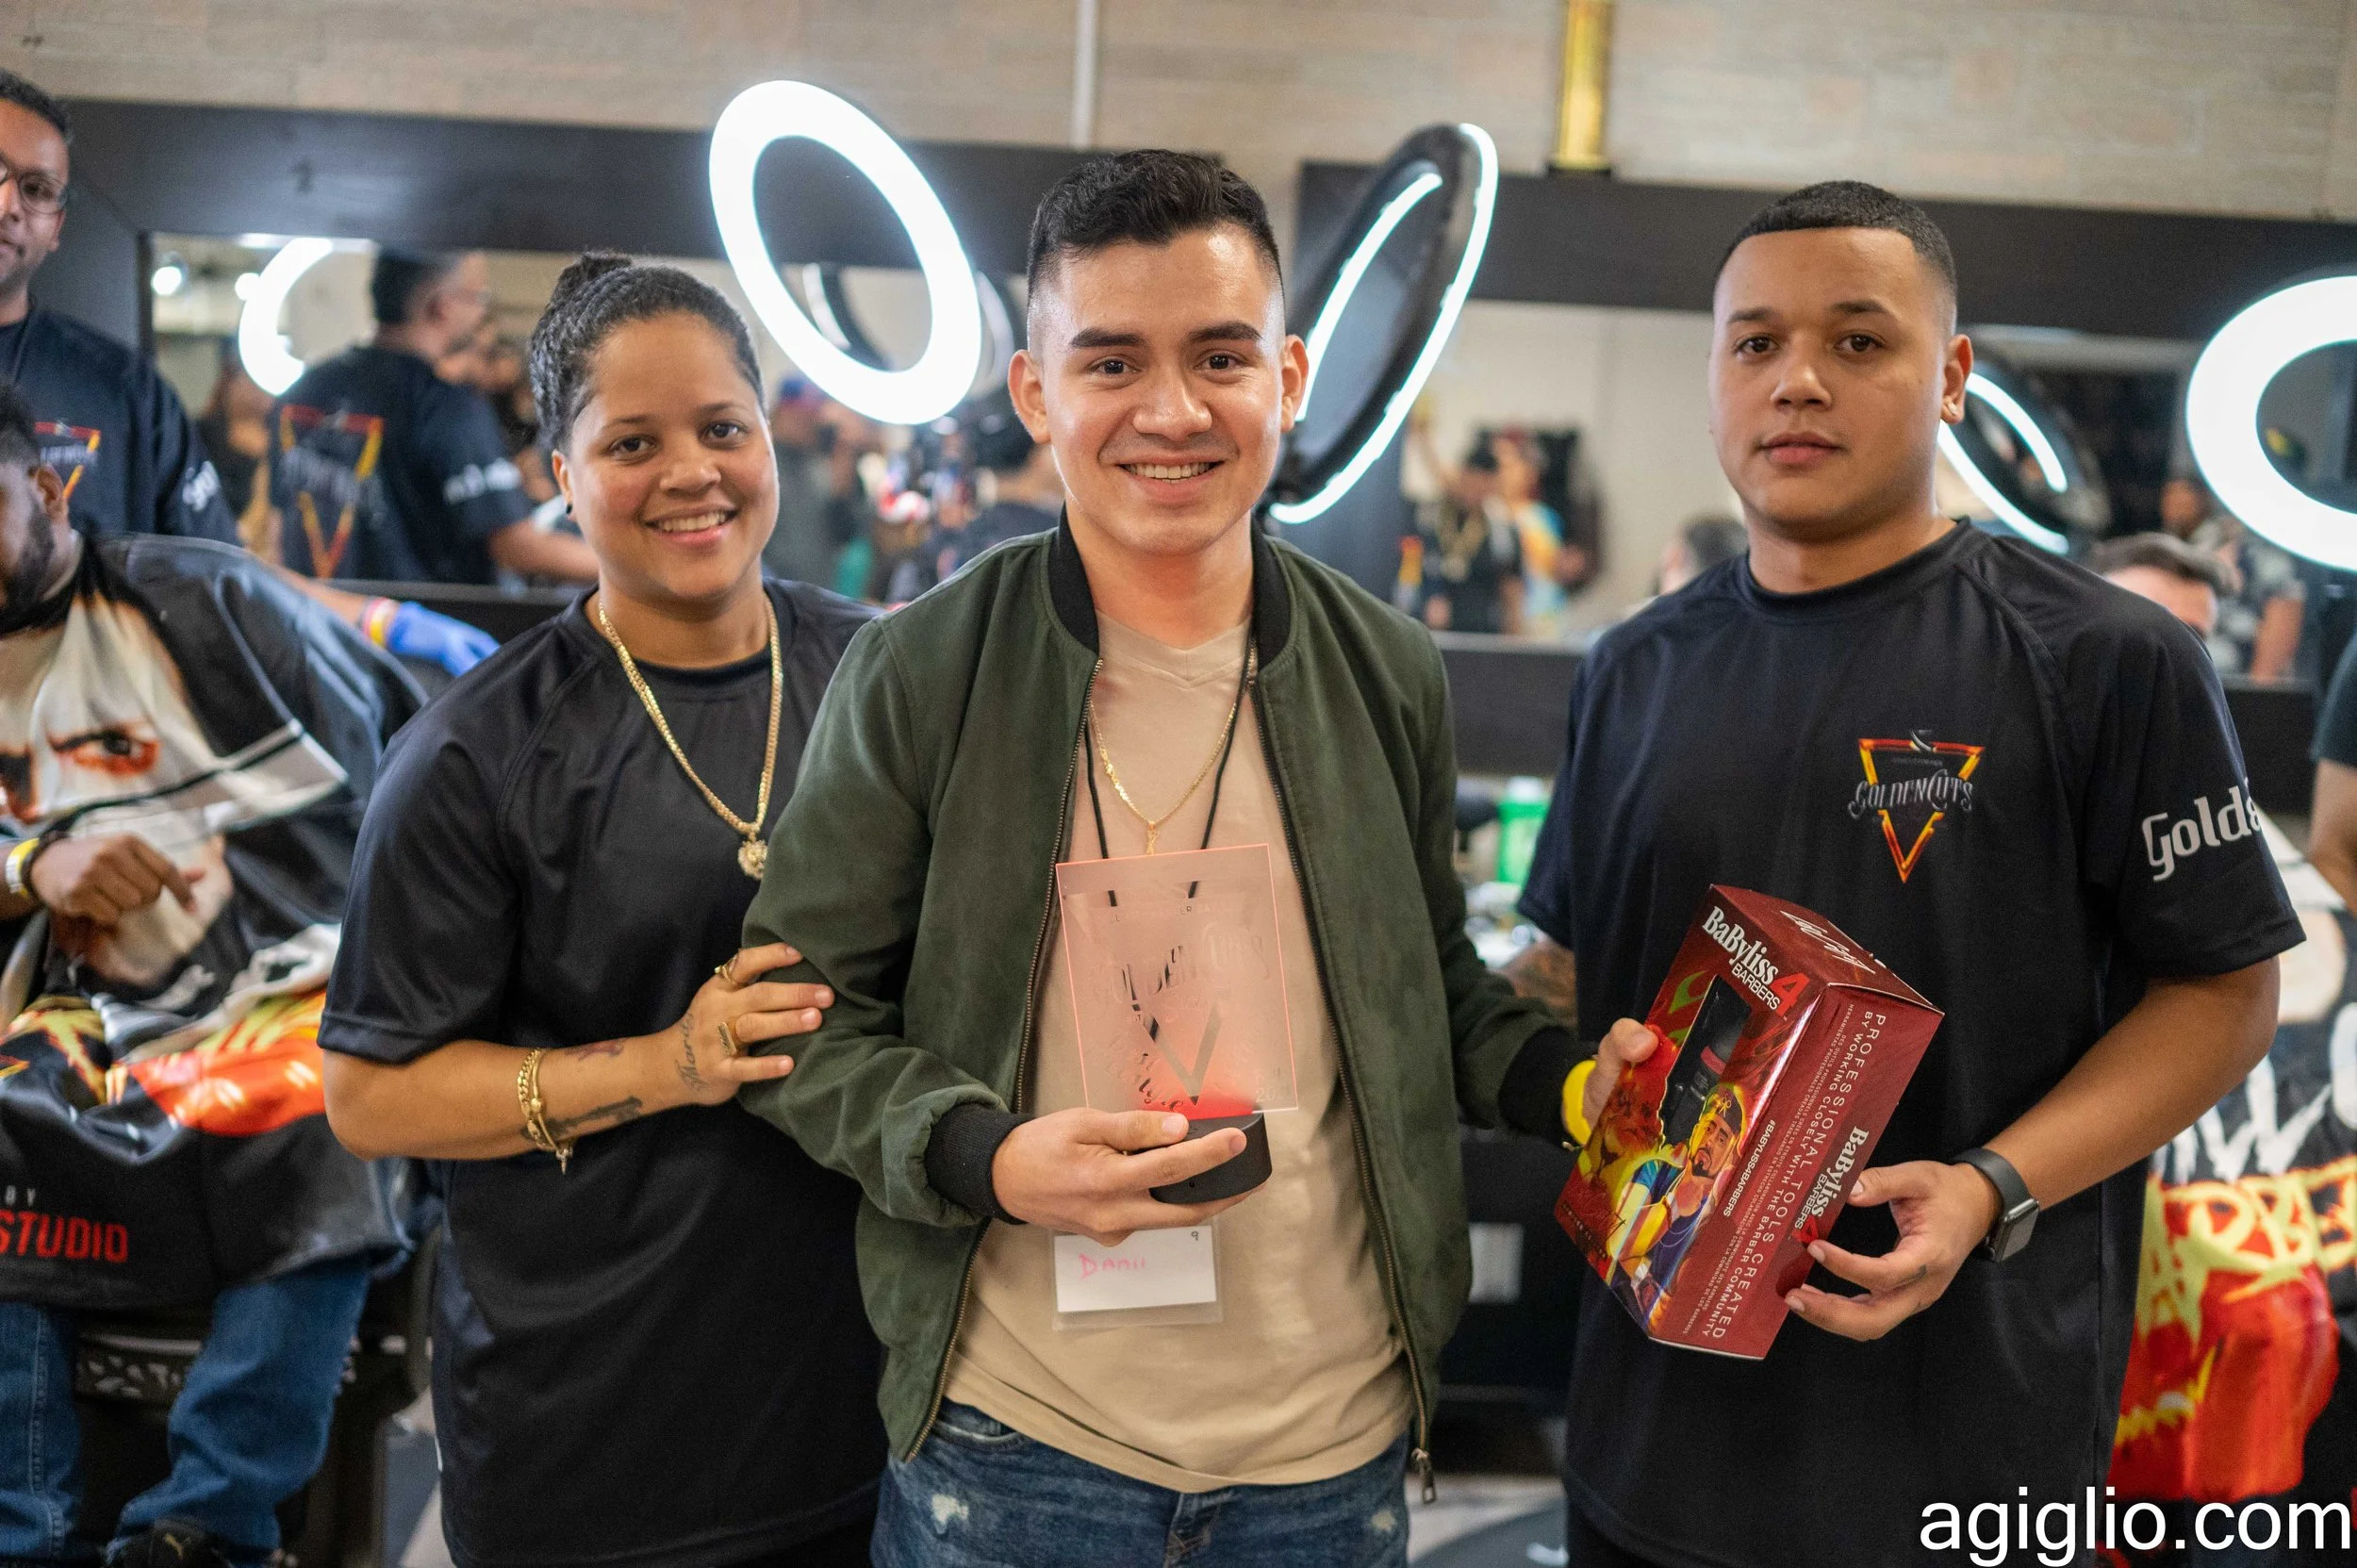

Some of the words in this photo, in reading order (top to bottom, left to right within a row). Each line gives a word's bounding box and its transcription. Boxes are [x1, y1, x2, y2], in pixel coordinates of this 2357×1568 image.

[1701, 904, 1779, 986] BaByliss
[1768, 972, 1810, 1019] 4
[1731, 962, 1781, 1011] BARBERS
[1859, 1010, 1873, 1028] BY
[1827, 1032, 1864, 1091] WORKING
[1798, 1013, 1887, 1170] PROFESSIONAL
[1798, 1095, 1832, 1149] CLOSELY
[1721, 1118, 1777, 1217] #BABYLISS4BARBERS
[1780, 1153, 1802, 1183] WITH
[1809, 1125, 1870, 1217] BaByliss
[1760, 1179, 1803, 1243] TOOLS
[1766, 1187, 1785, 1212] THE
[1793, 1173, 1828, 1230] BARBERS
[1739, 1214, 1771, 1263] BARBER
[1789, 1214, 1819, 1245] 4
[1700, 1266, 1743, 1336] COMMUNITY
[1710, 1252, 1765, 1339] CREATED
